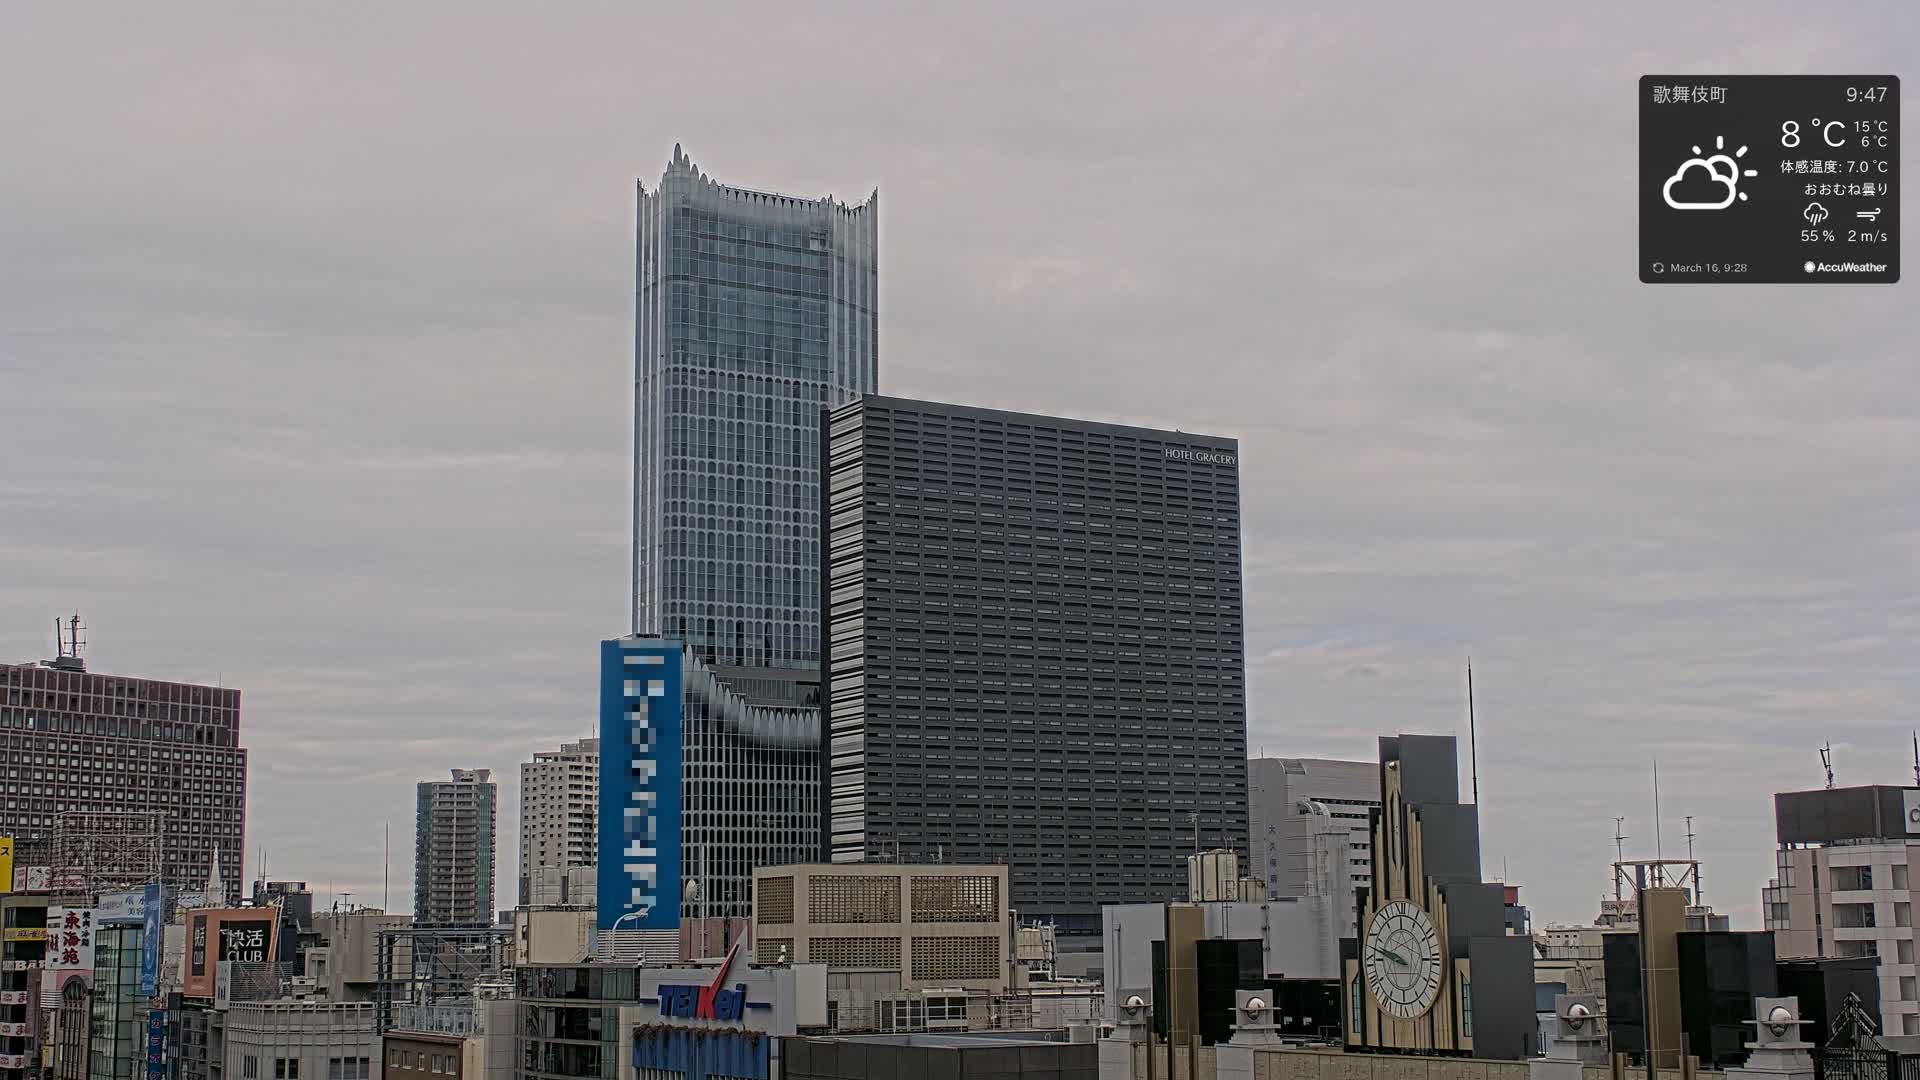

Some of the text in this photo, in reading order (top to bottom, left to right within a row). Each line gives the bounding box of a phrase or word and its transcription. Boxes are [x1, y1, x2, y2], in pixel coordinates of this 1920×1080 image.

[1165, 448, 1237, 465] HOTEL GRACERY
[62, 911, 81, 964] 東海苑
[229, 929, 264, 947] 快活
[228, 950, 263, 963] CLUB
